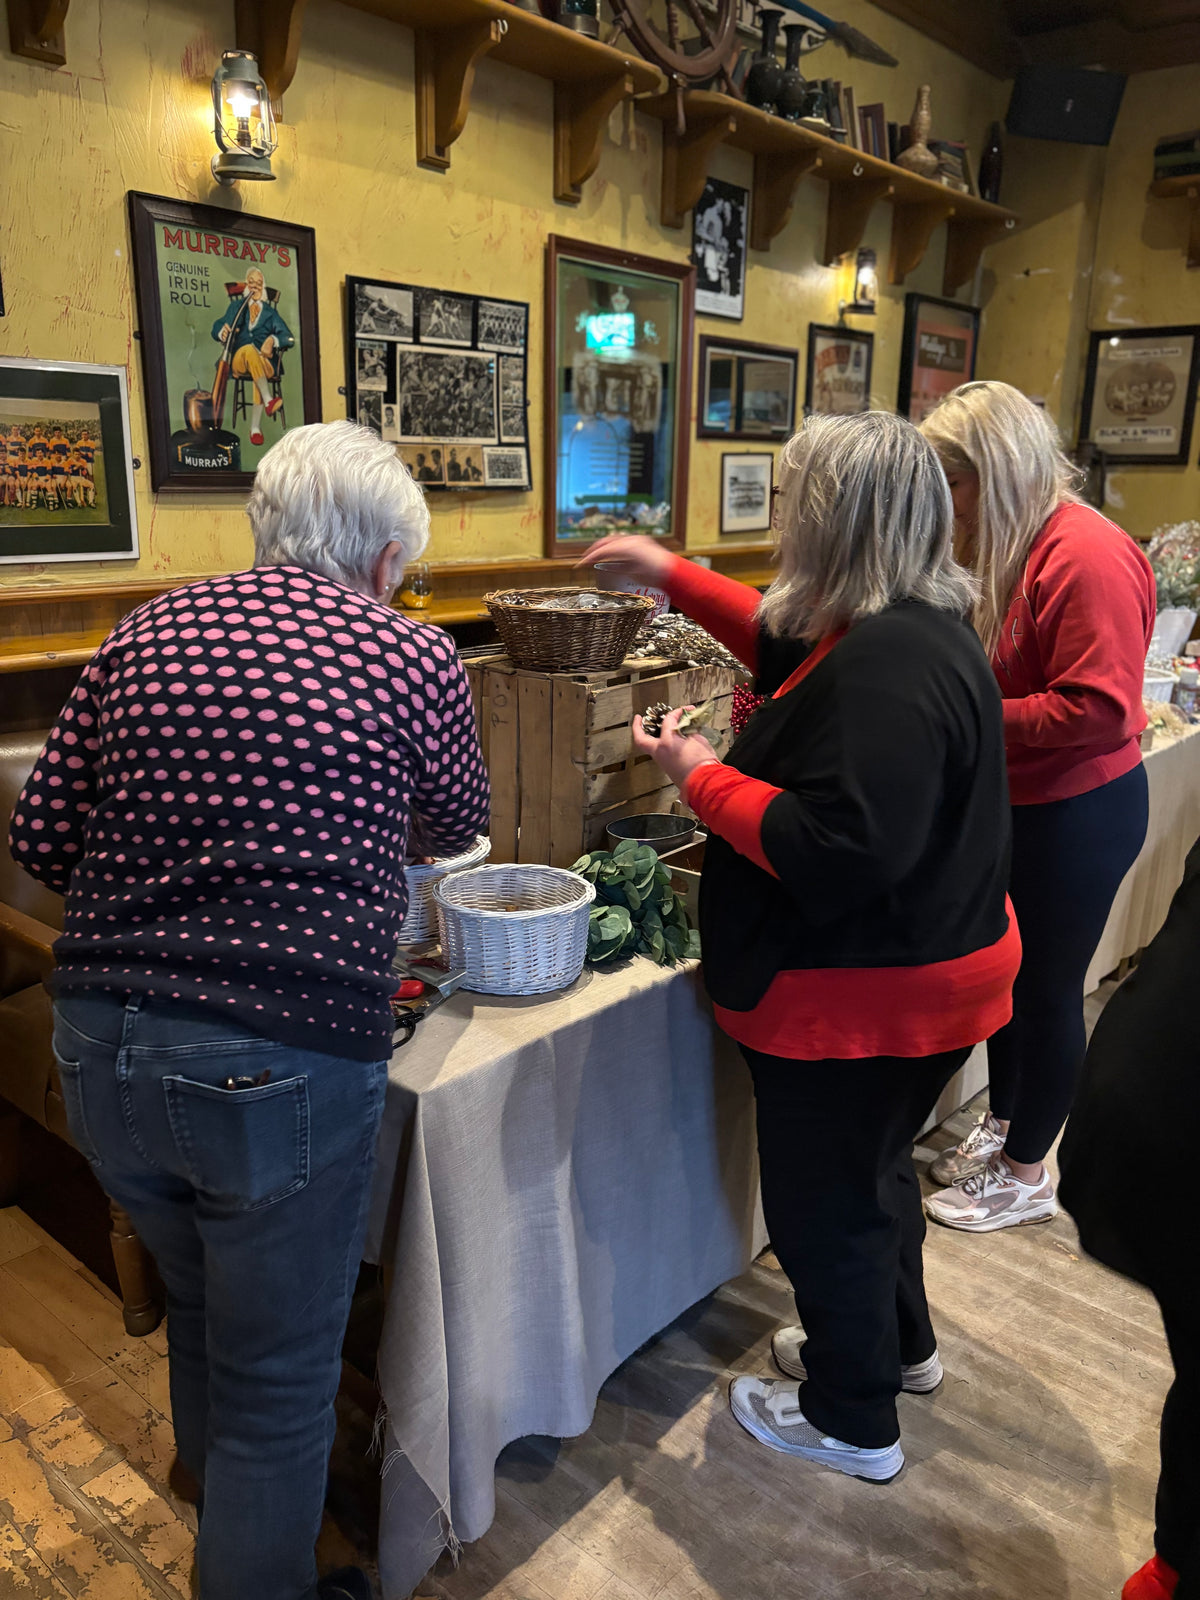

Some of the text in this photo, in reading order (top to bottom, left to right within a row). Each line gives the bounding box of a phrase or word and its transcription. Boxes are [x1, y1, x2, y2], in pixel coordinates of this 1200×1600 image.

[163, 226, 291, 268] MURRAY'S
[166, 261, 210, 277] GENUINE
[169, 275, 210, 293] IRISH
[170, 291, 211, 308] ROLL
[1099, 428, 1128, 437] BLACK
[1141, 427, 1172, 436] WHITE
